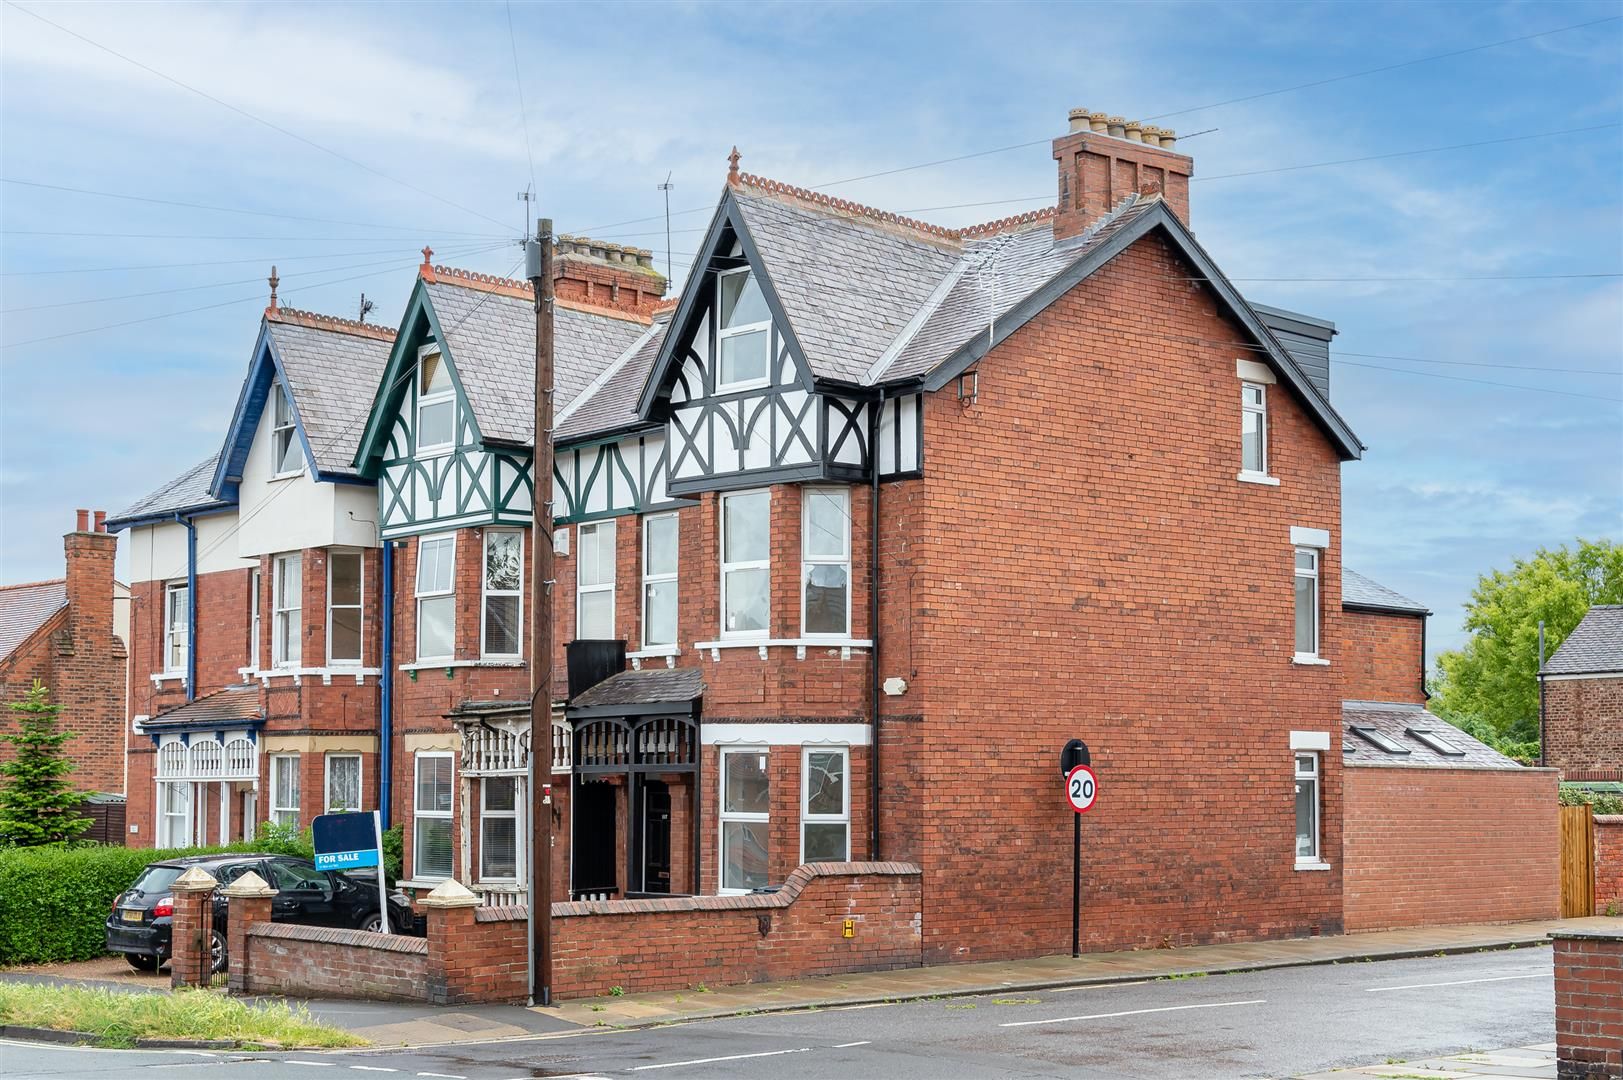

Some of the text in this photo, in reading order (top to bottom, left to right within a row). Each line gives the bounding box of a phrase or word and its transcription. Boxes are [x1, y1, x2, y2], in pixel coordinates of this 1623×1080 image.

[1072, 779, 1093, 798] 20
[318, 853, 359, 863] FOR SALE
[843, 920, 854, 936] H
